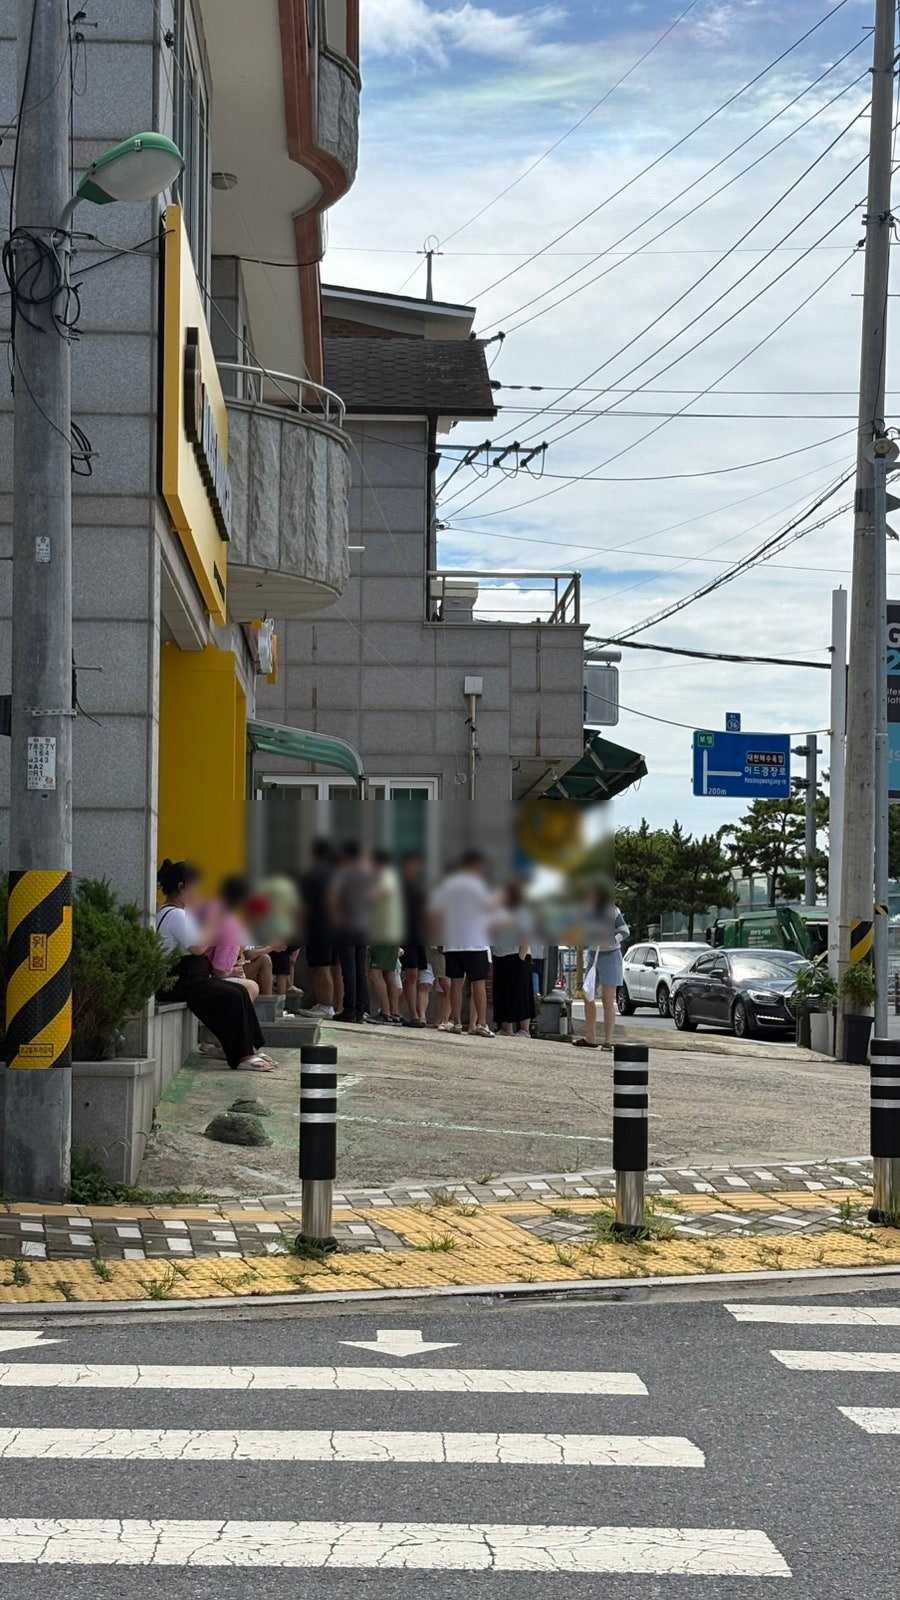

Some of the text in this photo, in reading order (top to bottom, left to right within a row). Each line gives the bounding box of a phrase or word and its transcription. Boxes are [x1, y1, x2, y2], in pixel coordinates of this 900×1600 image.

[699, 735, 713, 745] 보령
[747, 753, 784, 764] 대천해수욕장
[744, 766, 787, 778] 머드광장로
[708, 787, 727, 795] 200m
[32, 935, 45, 968] 위험
